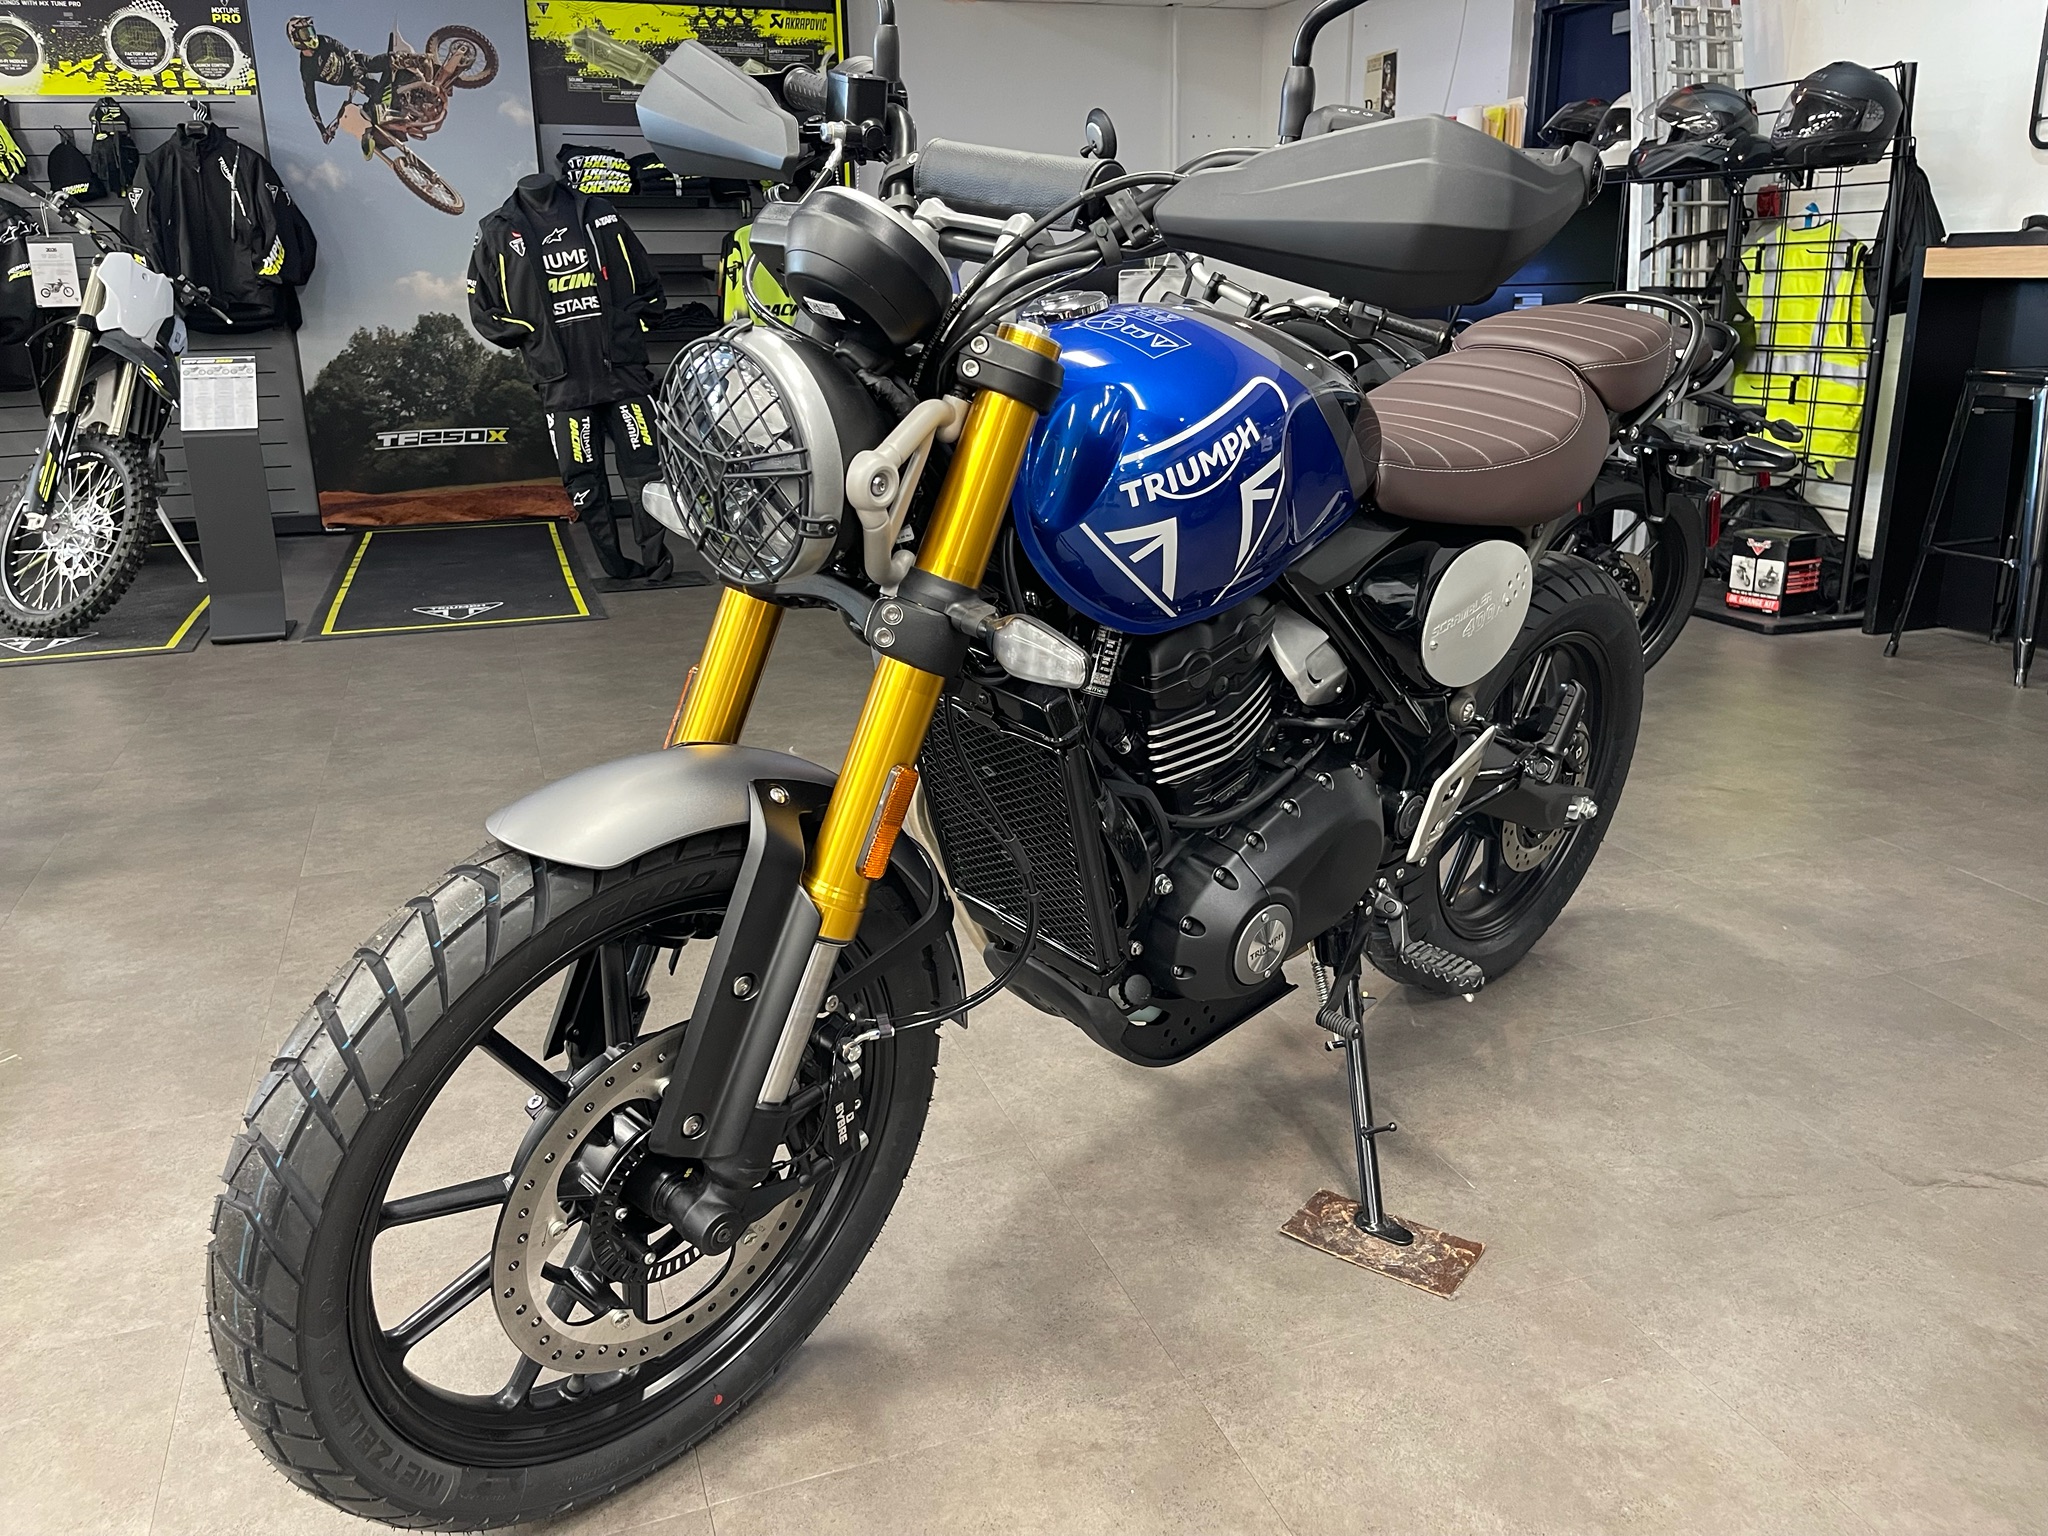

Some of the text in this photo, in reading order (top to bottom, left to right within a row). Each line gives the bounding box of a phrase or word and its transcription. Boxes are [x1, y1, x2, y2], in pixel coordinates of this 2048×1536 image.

[211, 13, 241, 24] PRO
[375, 428, 510, 450] TF250X
[568, 417, 584, 464] RACING
[580, 416, 594, 463] TRIUMPH
[618, 404, 641, 451] TRIUMPH
[630, 402, 654, 446] RACING
[1119, 417, 1261, 509] TRIUMPH
[1249, 931, 1285, 961] TRIUMPH
[834, 1101, 848, 1146] BYBRE
